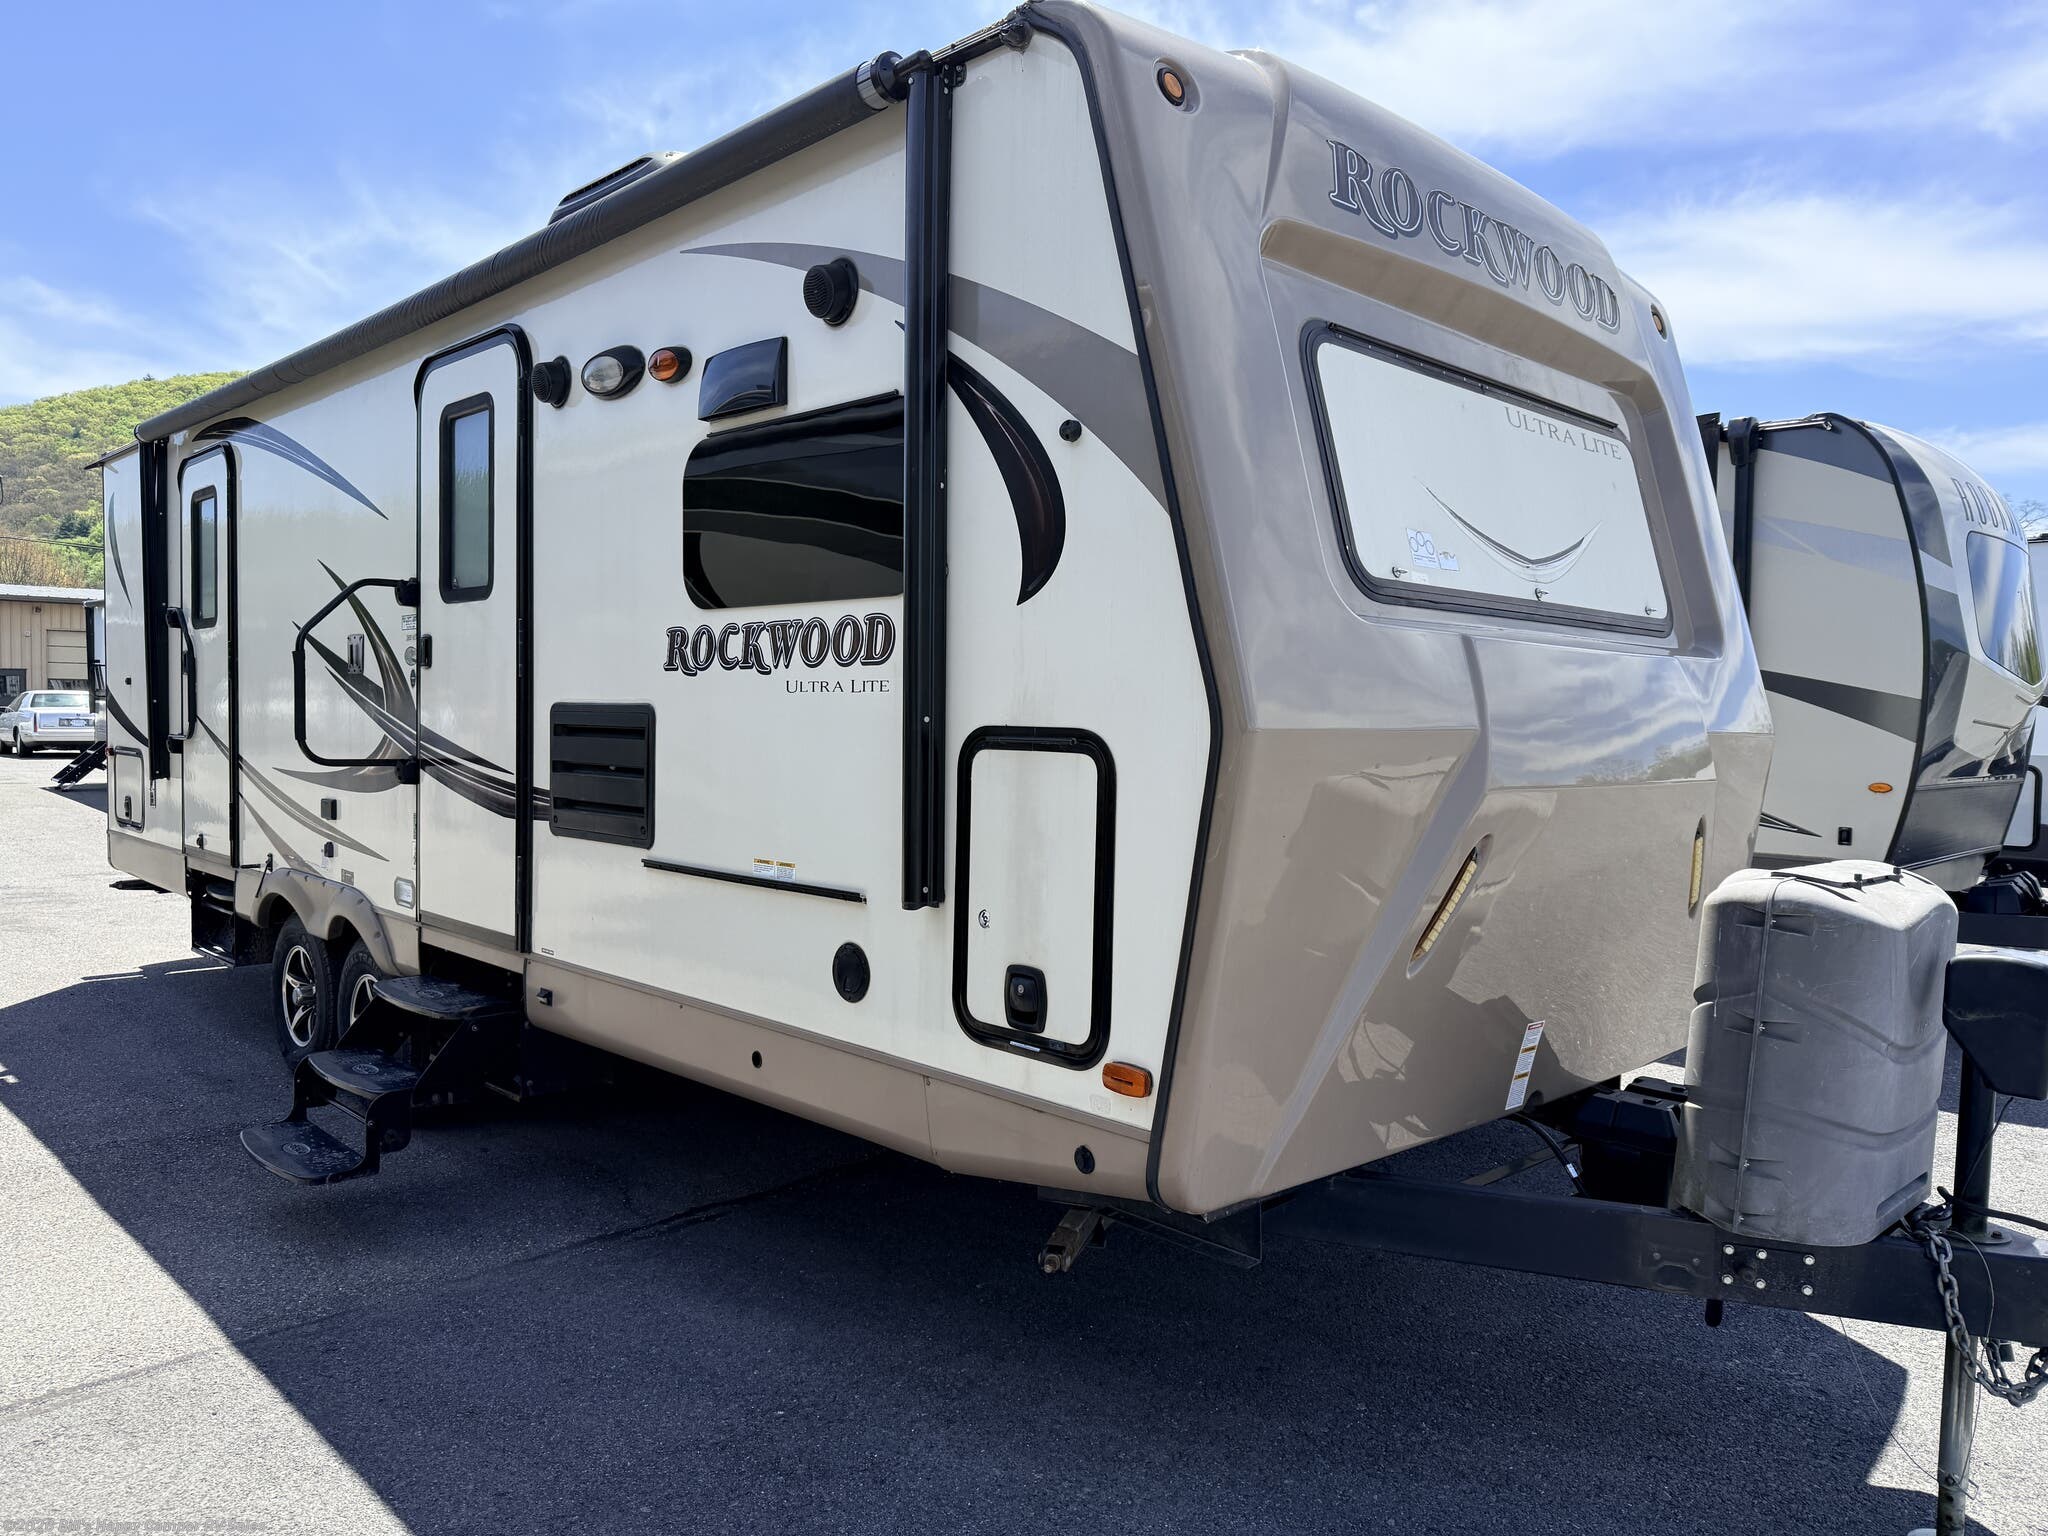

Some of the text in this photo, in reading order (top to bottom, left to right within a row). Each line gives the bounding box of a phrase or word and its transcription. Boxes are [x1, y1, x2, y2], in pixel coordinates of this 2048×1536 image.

[1326, 139, 1621, 334] ROCKWOOD
[1503, 405, 1622, 461] ULTRA LITE
[663, 612, 896, 677] ROCKWOOD
[785, 679, 890, 694] ULTRA LITE
